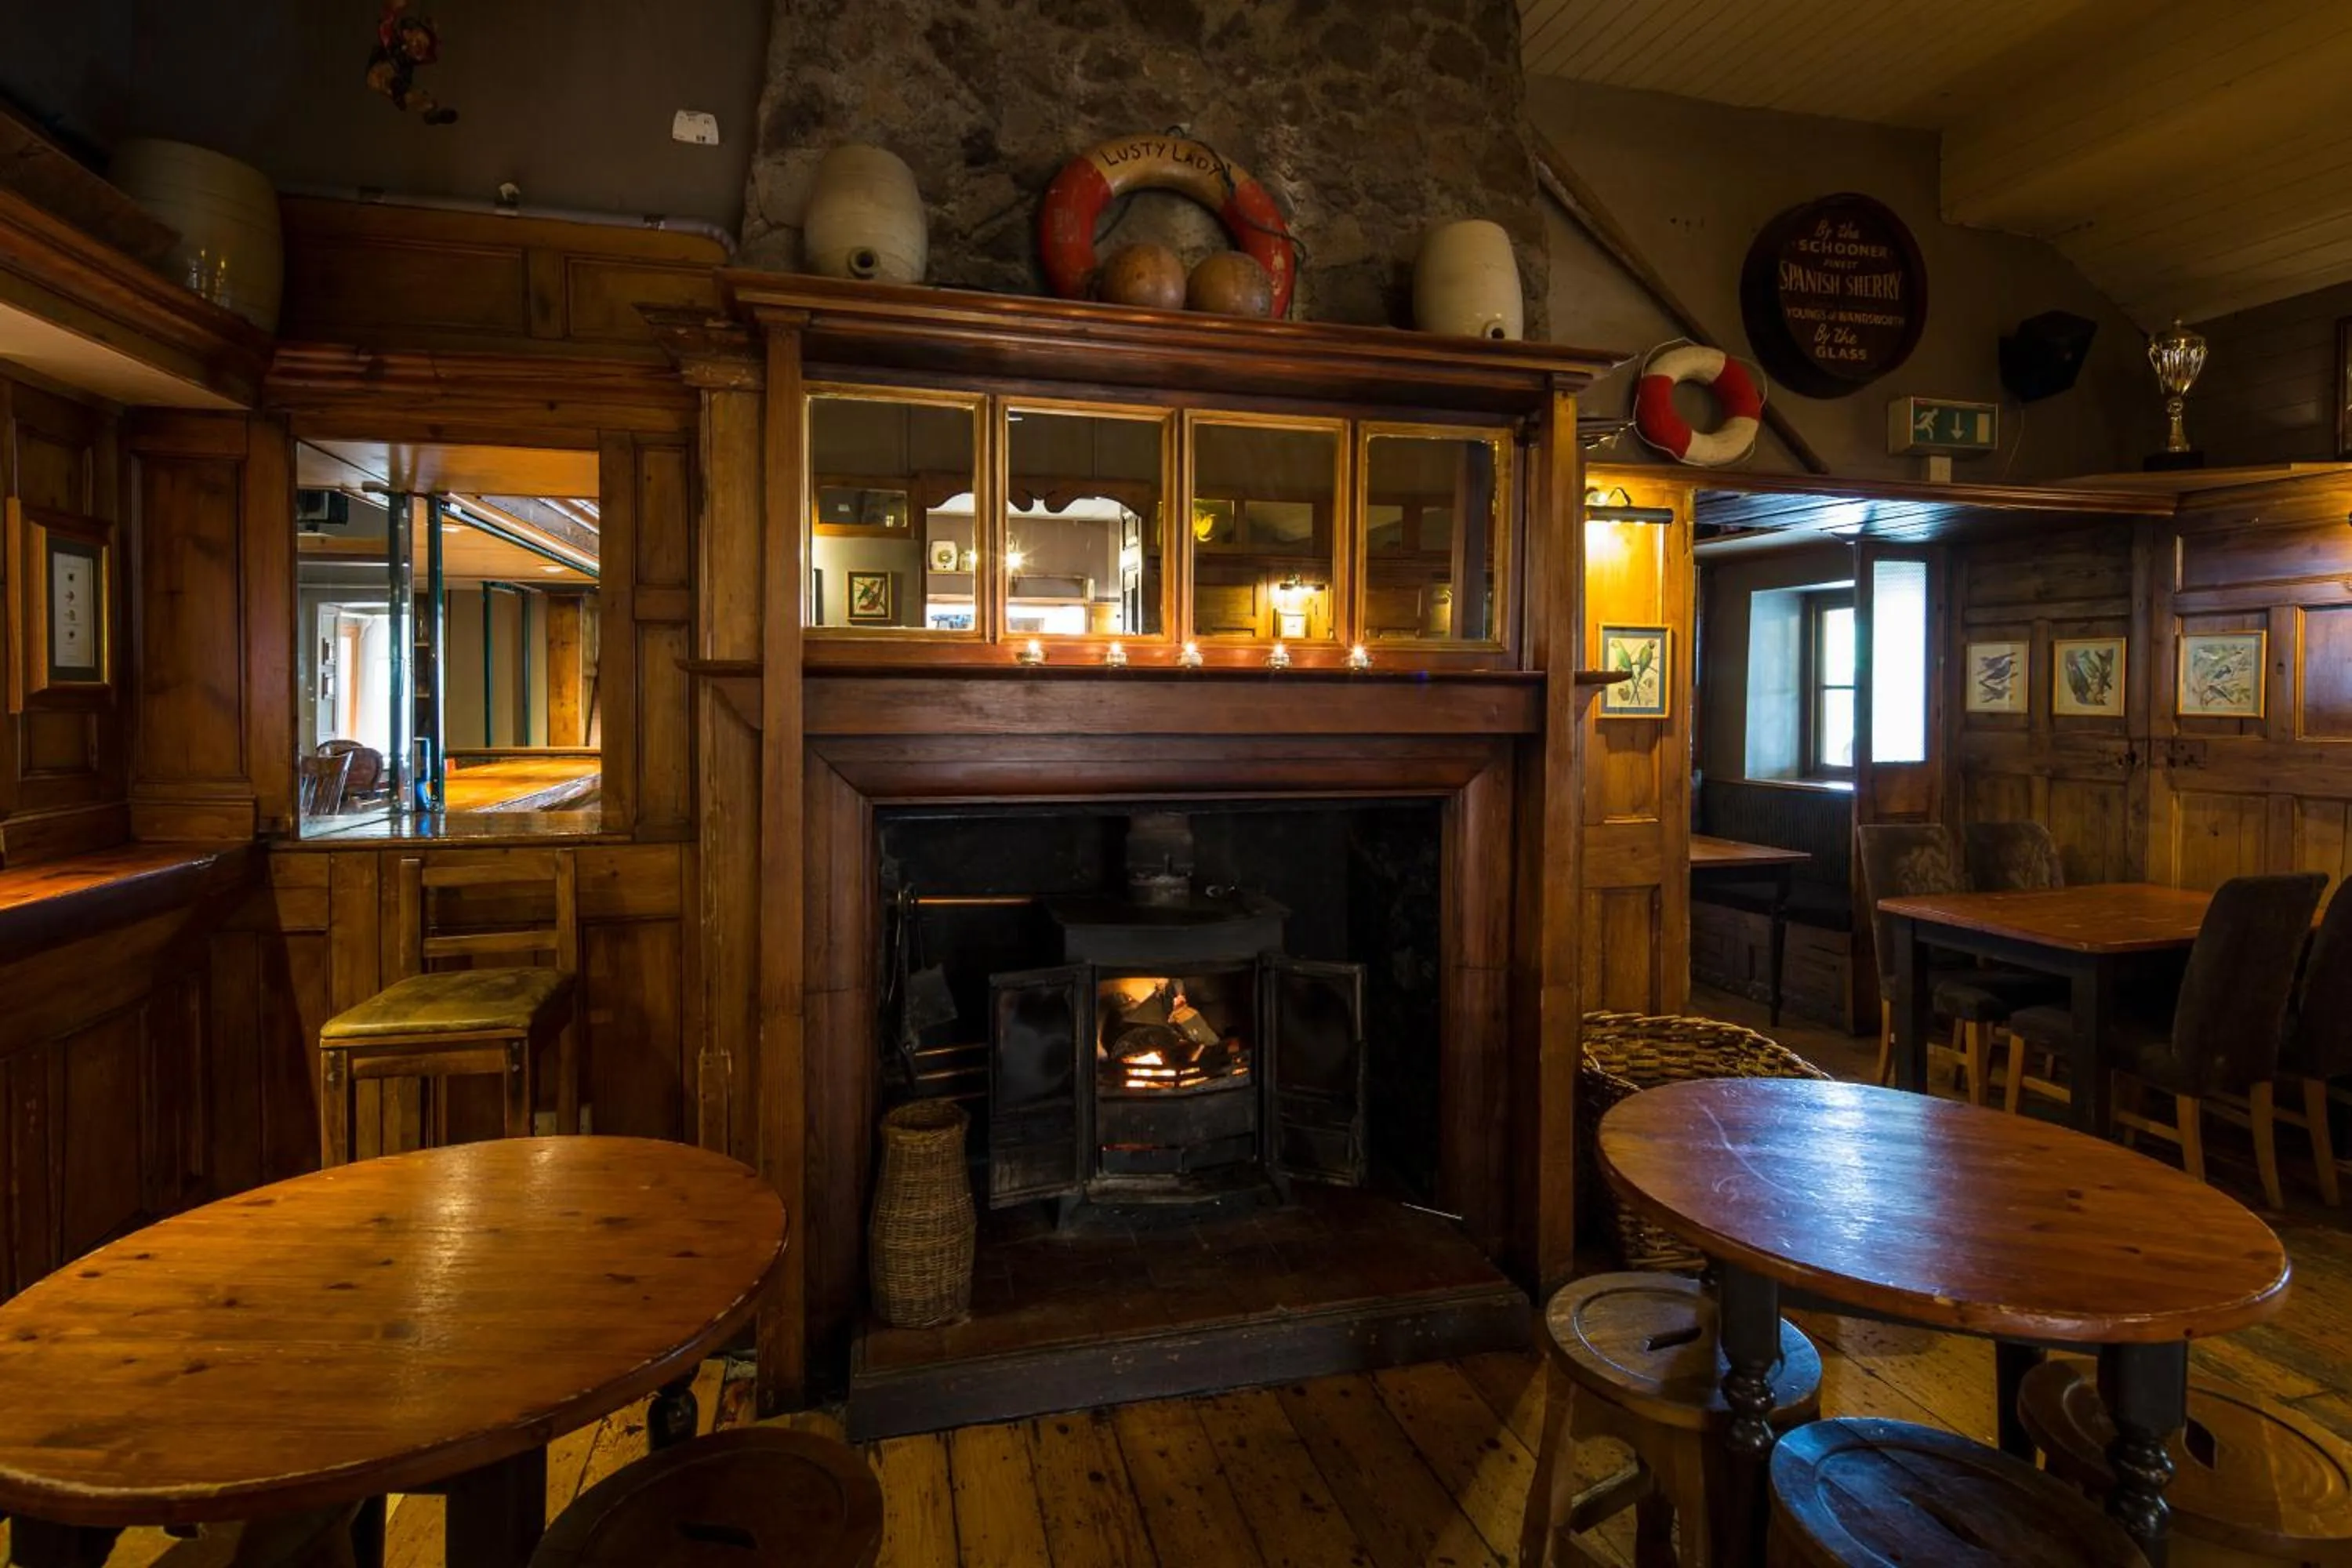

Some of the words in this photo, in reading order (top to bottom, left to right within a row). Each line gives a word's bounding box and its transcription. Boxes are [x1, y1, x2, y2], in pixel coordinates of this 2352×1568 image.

[1099, 142, 1165, 166] LUSTY
[1172, 143, 1221, 176] LADY
[1813, 217, 1833, 240] By
[1798, 238, 1888, 259] SCHOONER
[1778, 260, 1840, 297] SPANISH
[1845, 270, 1903, 301] SHERRY
[1813, 323, 1831, 344] By
[1815, 345, 1868, 361] GLASS
